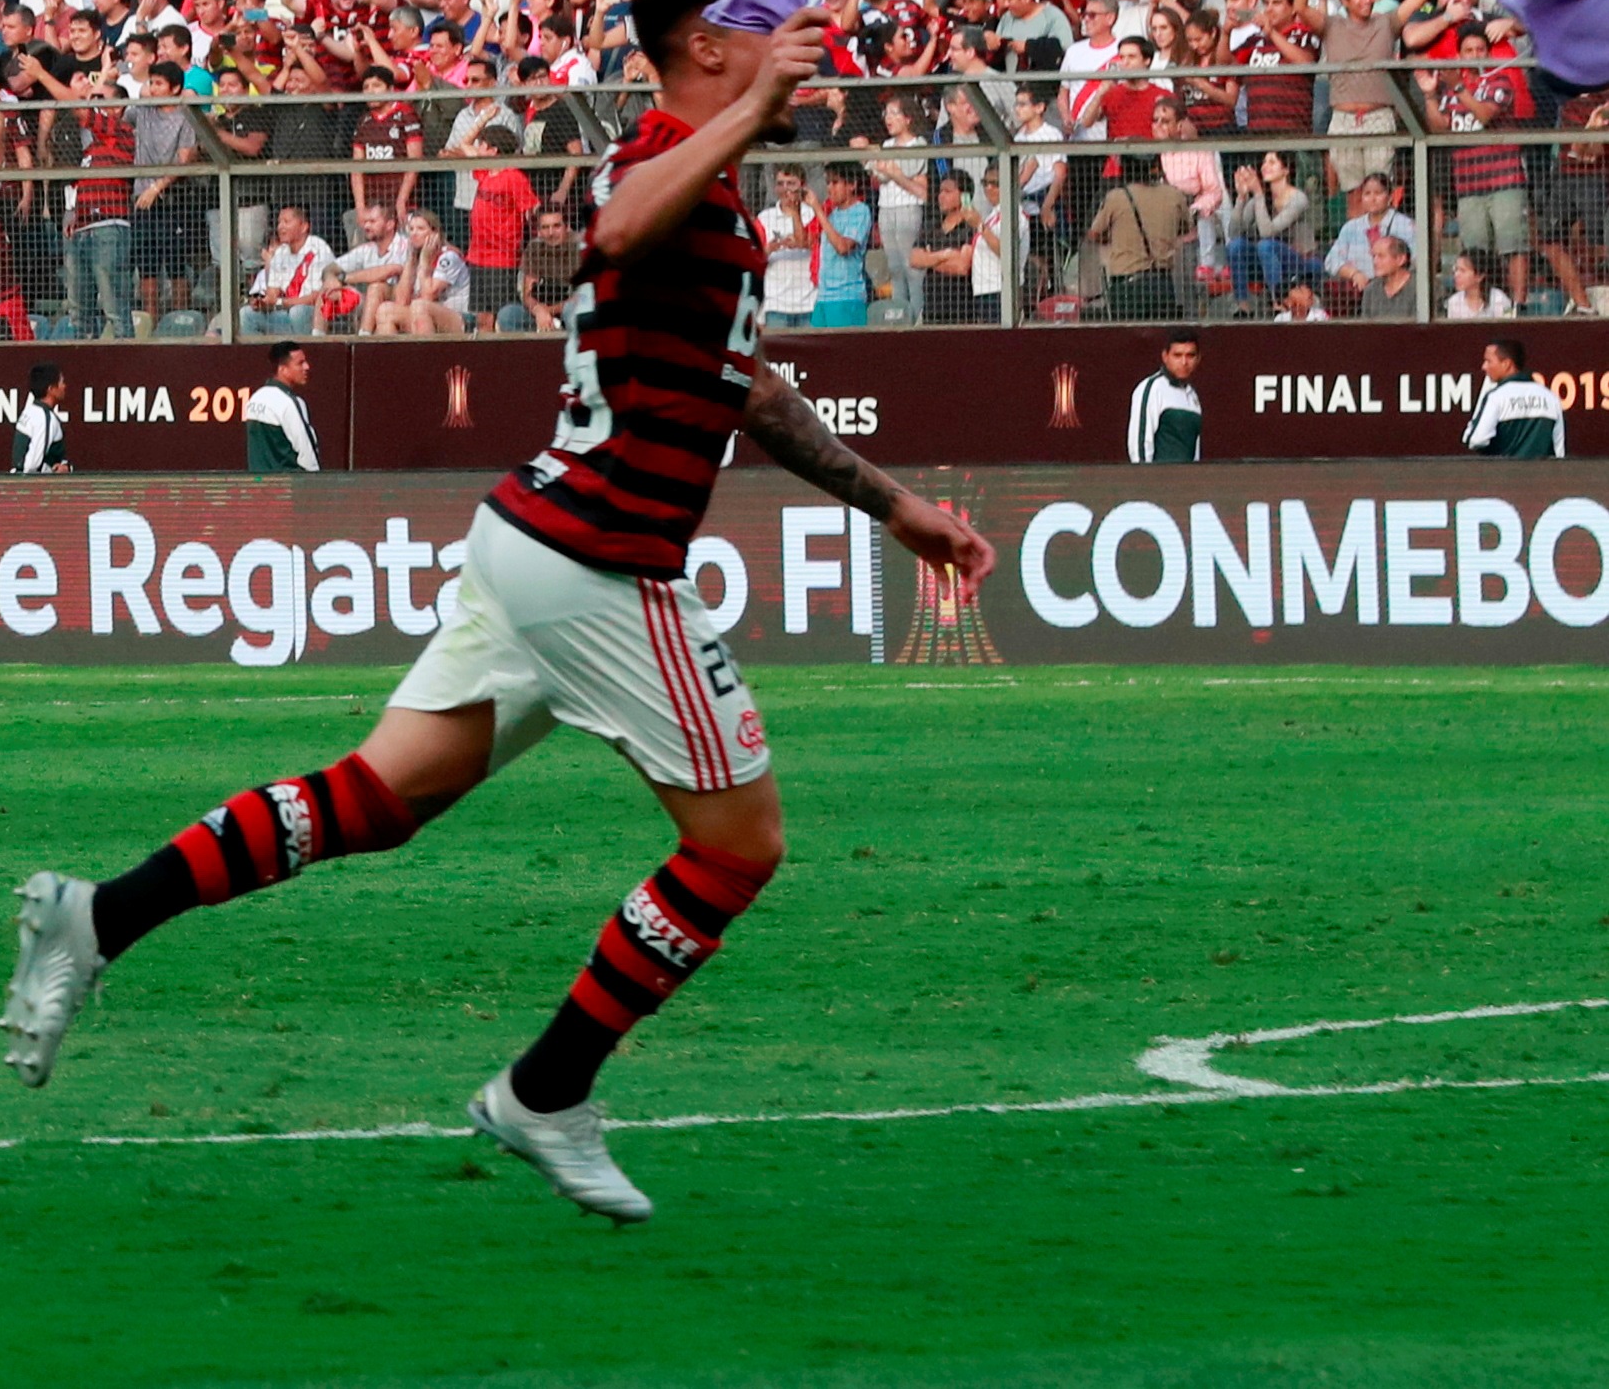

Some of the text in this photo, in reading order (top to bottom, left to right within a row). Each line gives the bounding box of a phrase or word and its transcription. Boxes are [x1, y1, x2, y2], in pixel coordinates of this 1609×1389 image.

[1249, 48, 1280, 67] bs2
[365, 142, 394, 159] bs2
[84, 387, 174, 423] LIMA
[189, 386, 251, 423] 201
[1254, 375, 1382, 413] FINAL
[622, 900, 688, 969] OYAL
